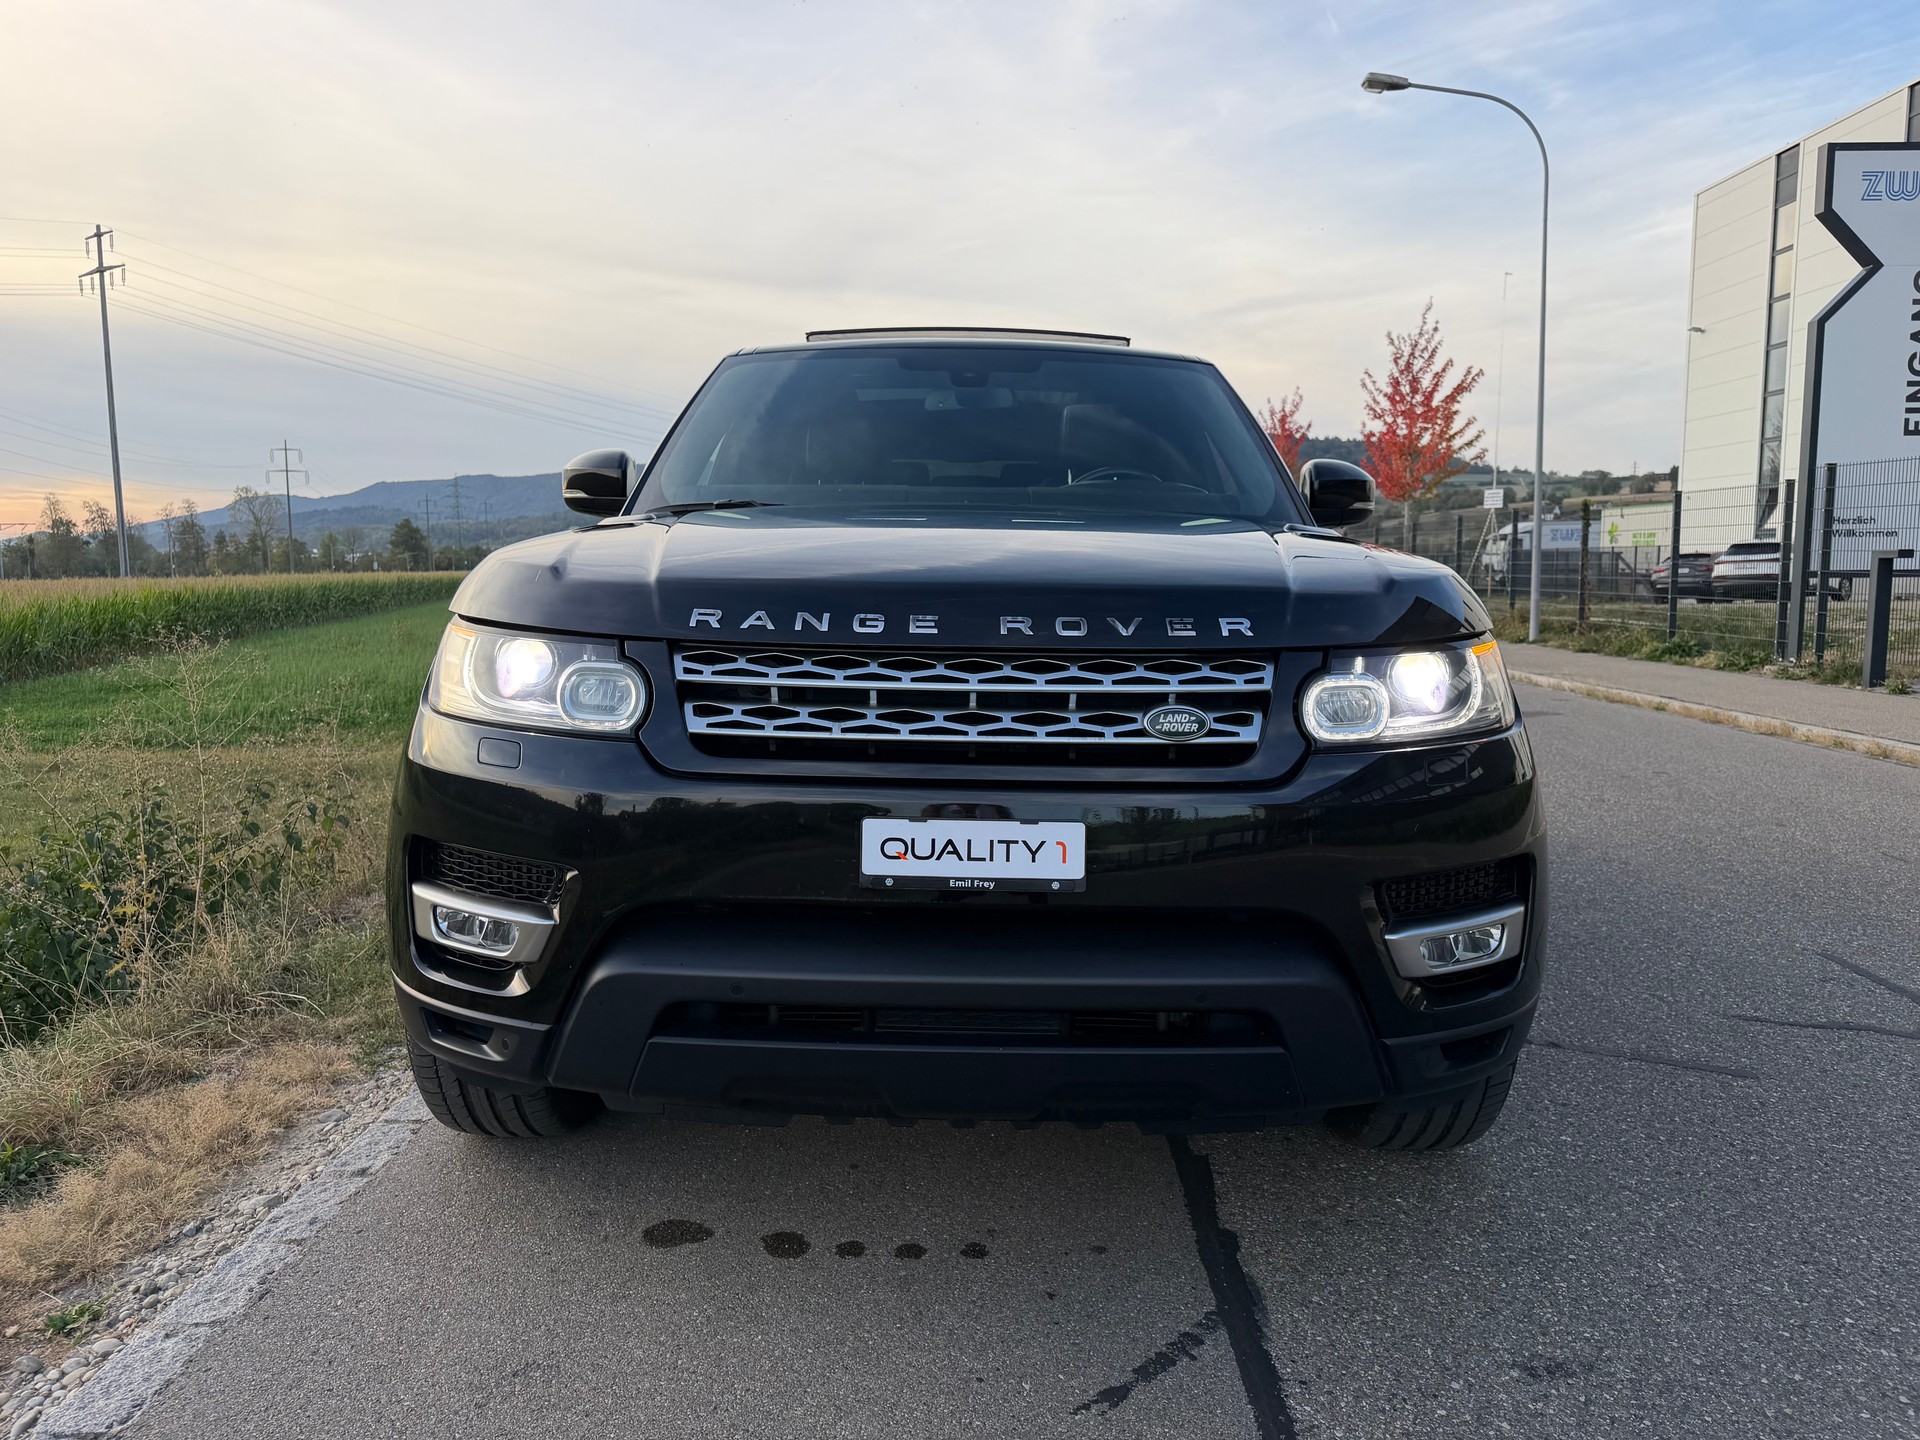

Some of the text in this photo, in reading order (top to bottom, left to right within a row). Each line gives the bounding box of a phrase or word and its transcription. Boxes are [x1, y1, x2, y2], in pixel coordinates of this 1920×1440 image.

[1832, 516, 1876, 525] Herzlich
[1832, 529, 1898, 538] Willkommen
[689, 608, 1254, 636] RANGE ROVER
[1159, 713, 1190, 723] LAND
[1161, 723, 1199, 733] ROVER
[880, 837, 1047, 863] QUALITY
[949, 879, 996, 889] Emil Frey
